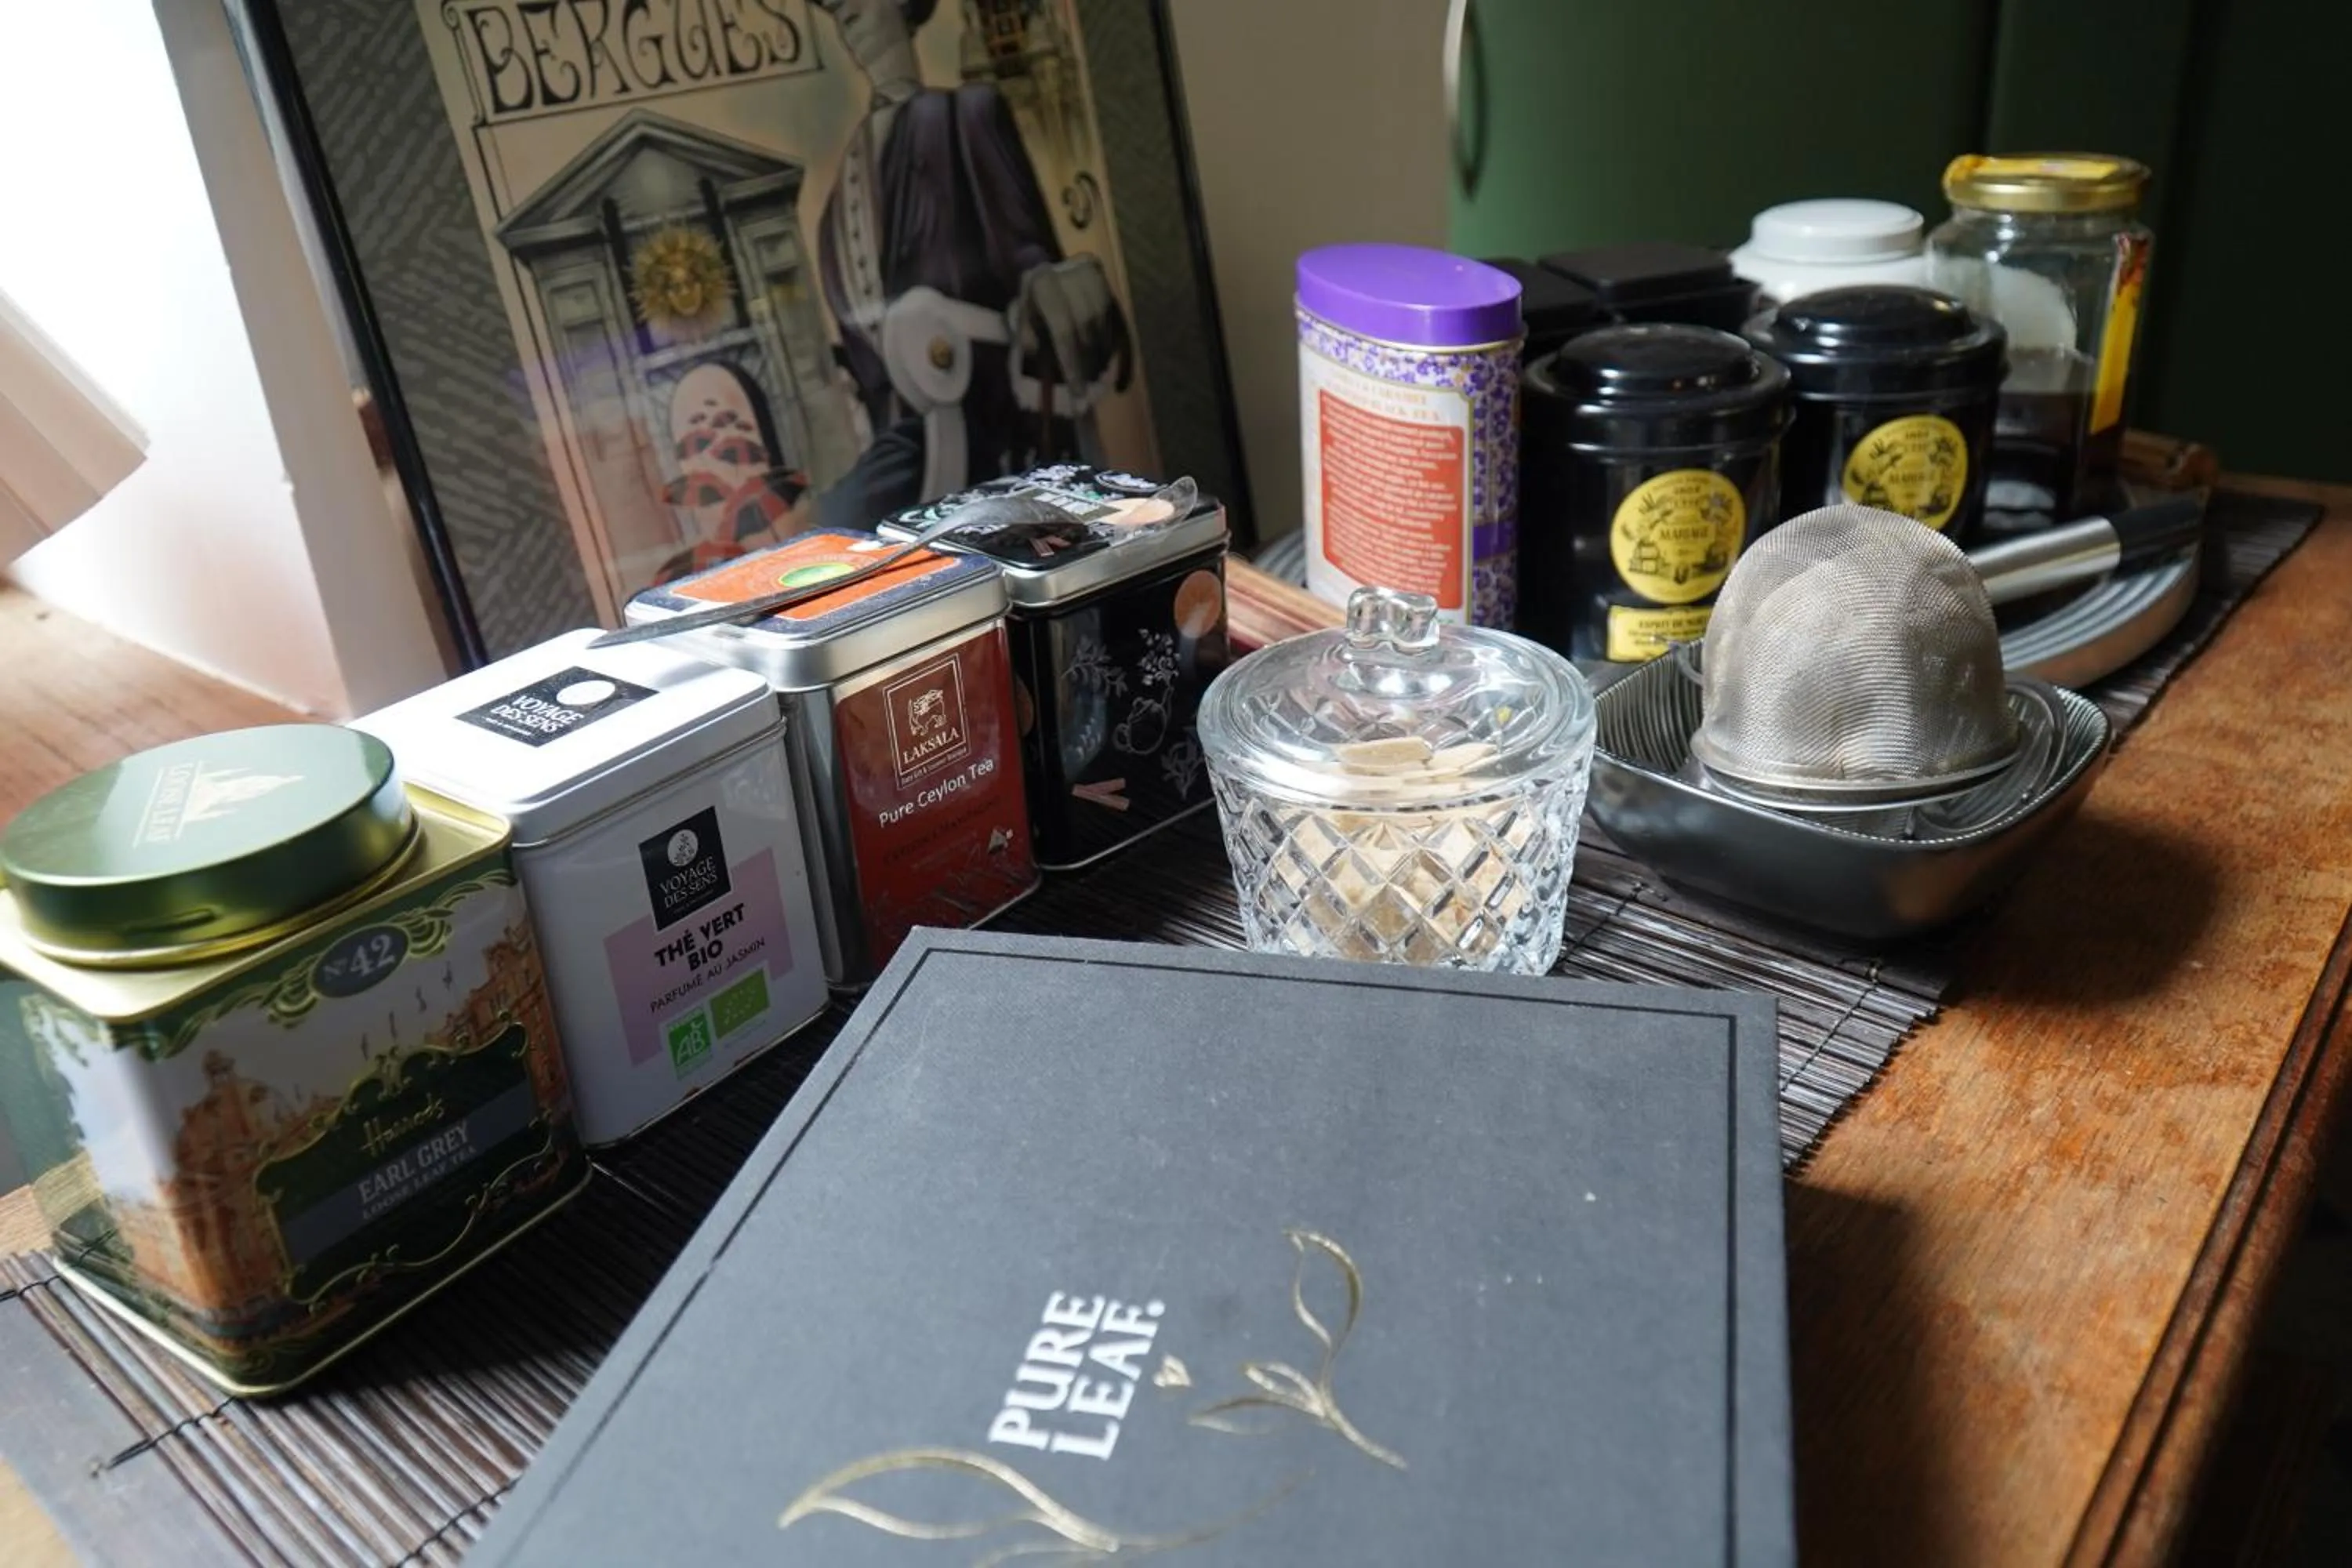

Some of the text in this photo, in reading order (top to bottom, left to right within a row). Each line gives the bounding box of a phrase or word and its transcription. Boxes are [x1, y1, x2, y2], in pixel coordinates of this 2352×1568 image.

[467, 0, 801, 114] BERGUES
[491, 704, 528, 720] DES
[517, 713, 564, 733] SENS
[512, 695, 584, 724] VOYAGE
[902, 727, 960, 764] LAKSALA
[879, 801, 914, 829] Pure
[917, 774, 967, 808] Ceylon
[968, 758, 994, 780] Tea
[659, 855, 717, 895] VOYAGE
[664, 887, 688, 909] DES
[688, 873, 718, 895] SENS
[350, 934, 395, 978] 42
[654, 902, 745, 967] THÉ VERT
[687, 939, 724, 971] BIO
[707, 964, 723, 979] AU
[726, 936, 766, 971] JASMIN
[358, 1118, 469, 1204] EARL GREY
[988, 1290, 1105, 1450] PURE
[1050, 1299, 1167, 1461] LEAF.
